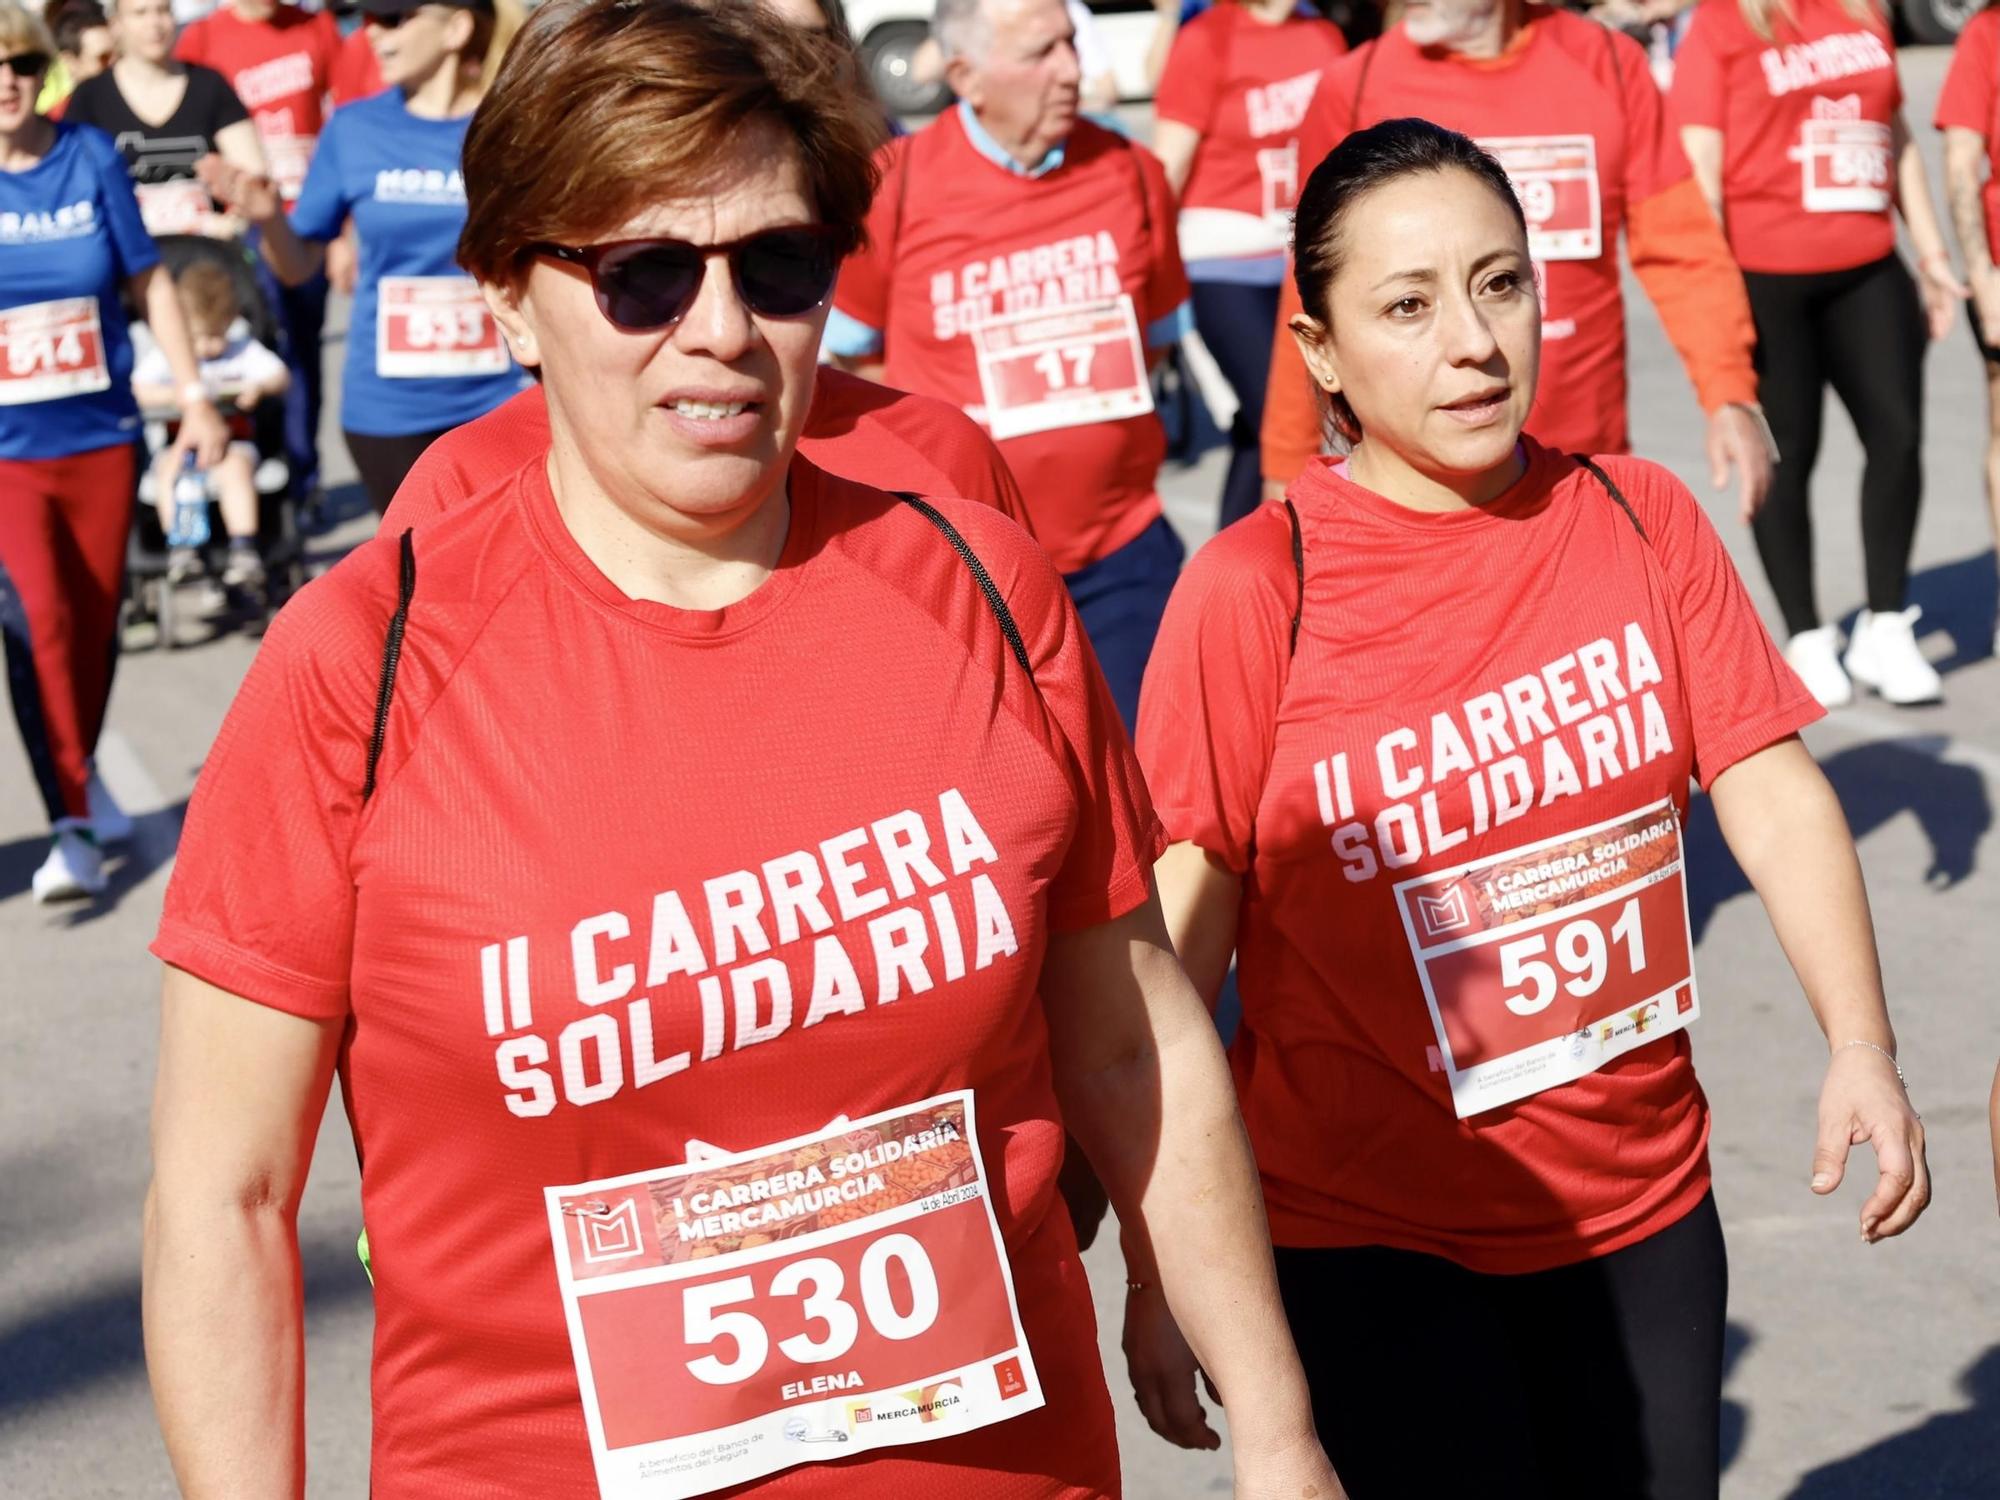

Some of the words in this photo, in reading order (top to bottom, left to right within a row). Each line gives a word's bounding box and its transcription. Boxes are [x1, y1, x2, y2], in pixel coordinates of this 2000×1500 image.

[1510, 178, 1556, 225] 9
[962, 230, 1119, 298] CARRERA
[934, 264, 1122, 340] SOLIDARIA
[1034, 345, 1095, 390] 17
[1313, 751, 1355, 826] II
[1375, 621, 1663, 800] CARRERA
[1331, 690, 1675, 883] SOLIDARIA
[1484, 880, 1496, 898] I
[1497, 852, 1591, 893] CARRERA
[1491, 857, 1629, 913] MERCAMURCIA
[481, 935, 533, 1037] II
[570, 788, 999, 1008] CARRERA
[1499, 897, 1646, 1016] 591
[495, 873, 1019, 1119] SOLIDARIA
[672, 1197, 684, 1218] I
[690, 1164, 827, 1214] CARRERA
[676, 1172, 886, 1243] MERCAMURCIA
[682, 1233, 940, 1385] 530
[780, 1370, 865, 1401] ELENA
[876, 1394, 961, 1422] MERCAMURCIA
[648, 1451, 697, 1470] beneficio
[698, 1447, 715, 1460] del
[717, 1437, 749, 1454] Banco
[751, 1432, 764, 1444] de
[694, 1457, 711, 1470] del
[713, 1447, 749, 1466] Segura
